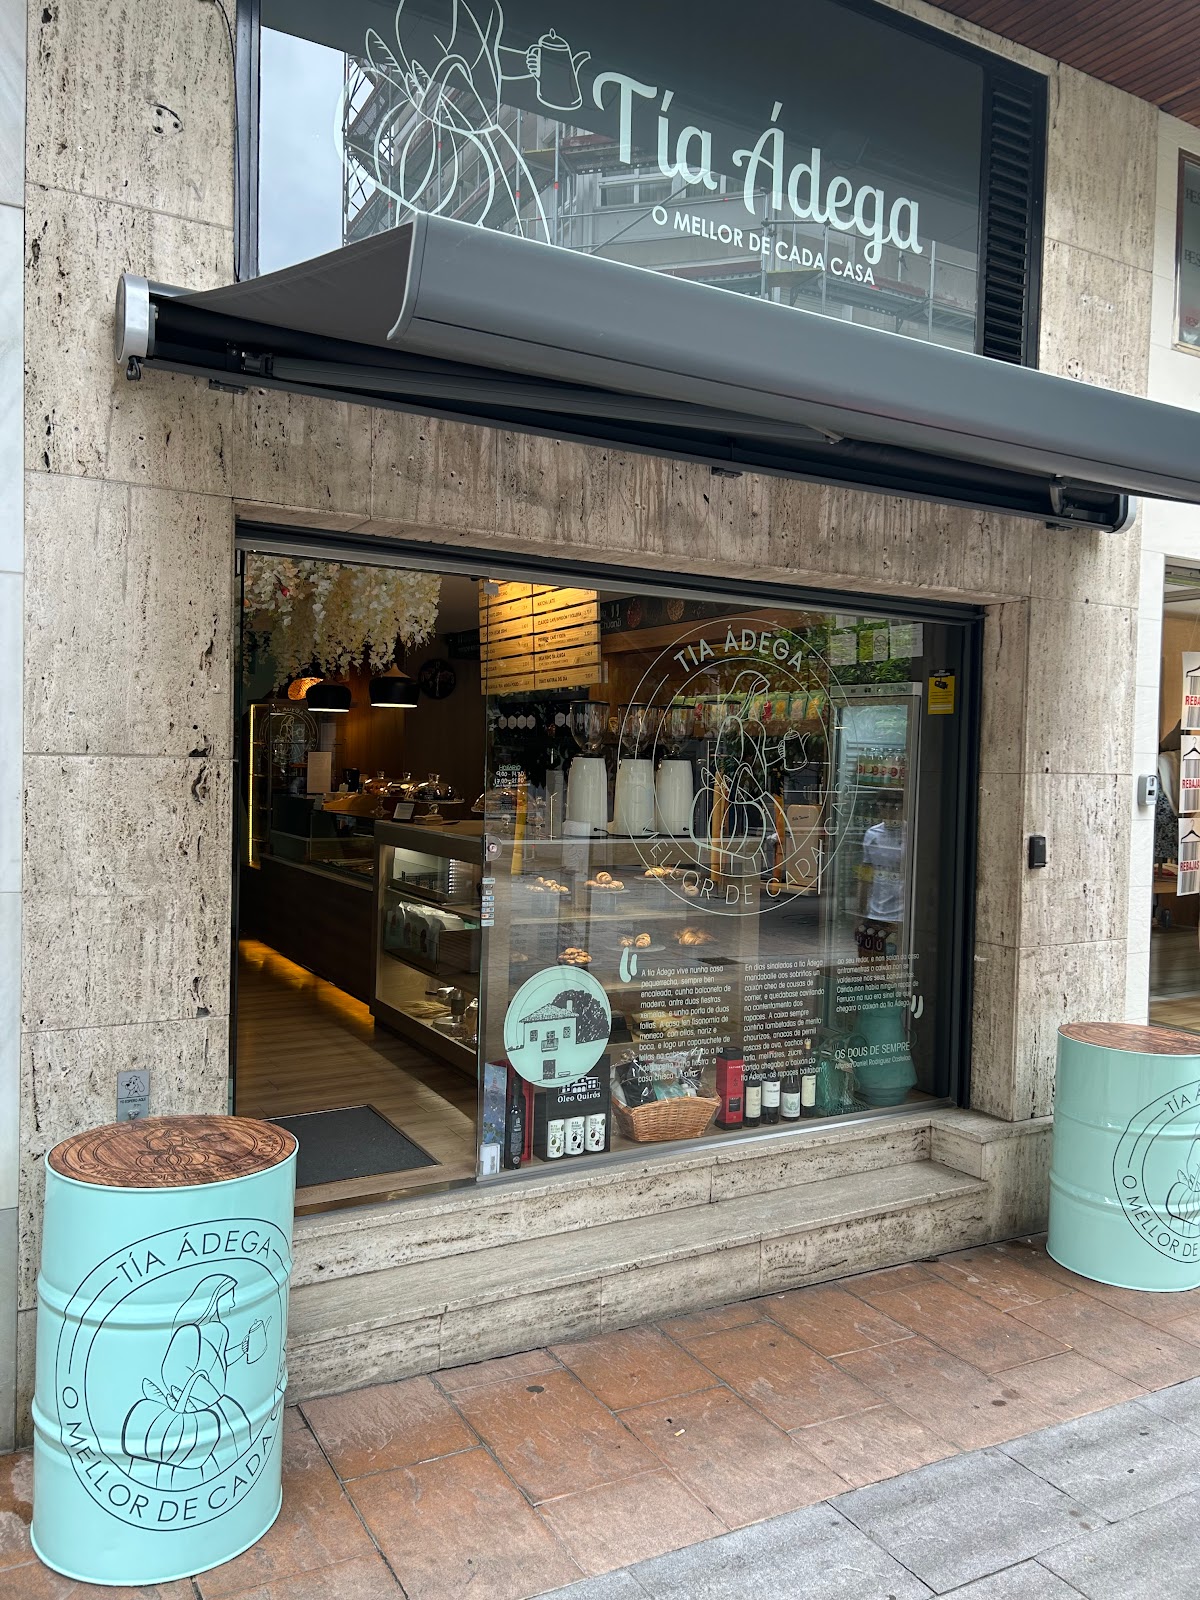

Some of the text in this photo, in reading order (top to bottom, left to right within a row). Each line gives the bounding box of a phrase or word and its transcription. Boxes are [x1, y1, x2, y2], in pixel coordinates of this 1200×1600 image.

[592, 71, 922, 264] Tía Ádega
[652, 205, 876, 285] O MELLOR DE CADA CASA
[724, 624, 803, 673] ÁDEGA
[640, 817, 714, 900] MELLOR
[725, 884, 753, 905] DE
[765, 846, 826, 898] CADA
[681, 977, 702, 985] sempre
[764, 982, 777, 990] cheo
[691, 1007, 706, 1016] porta
[663, 1041, 676, 1049] logo
[835, 1042, 910, 1059] OS DOUS DE SEMPRE
[557, 1092, 600, 1103] Oleo Quirós
[1164, 1095, 1190, 1114] TÍA
[1122, 1175, 1199, 1258] O MELLOR DE
[116, 1230, 273, 1283] TÍA ÁDEGA
[62, 1386, 273, 1522] O MELLOR DE CADA
